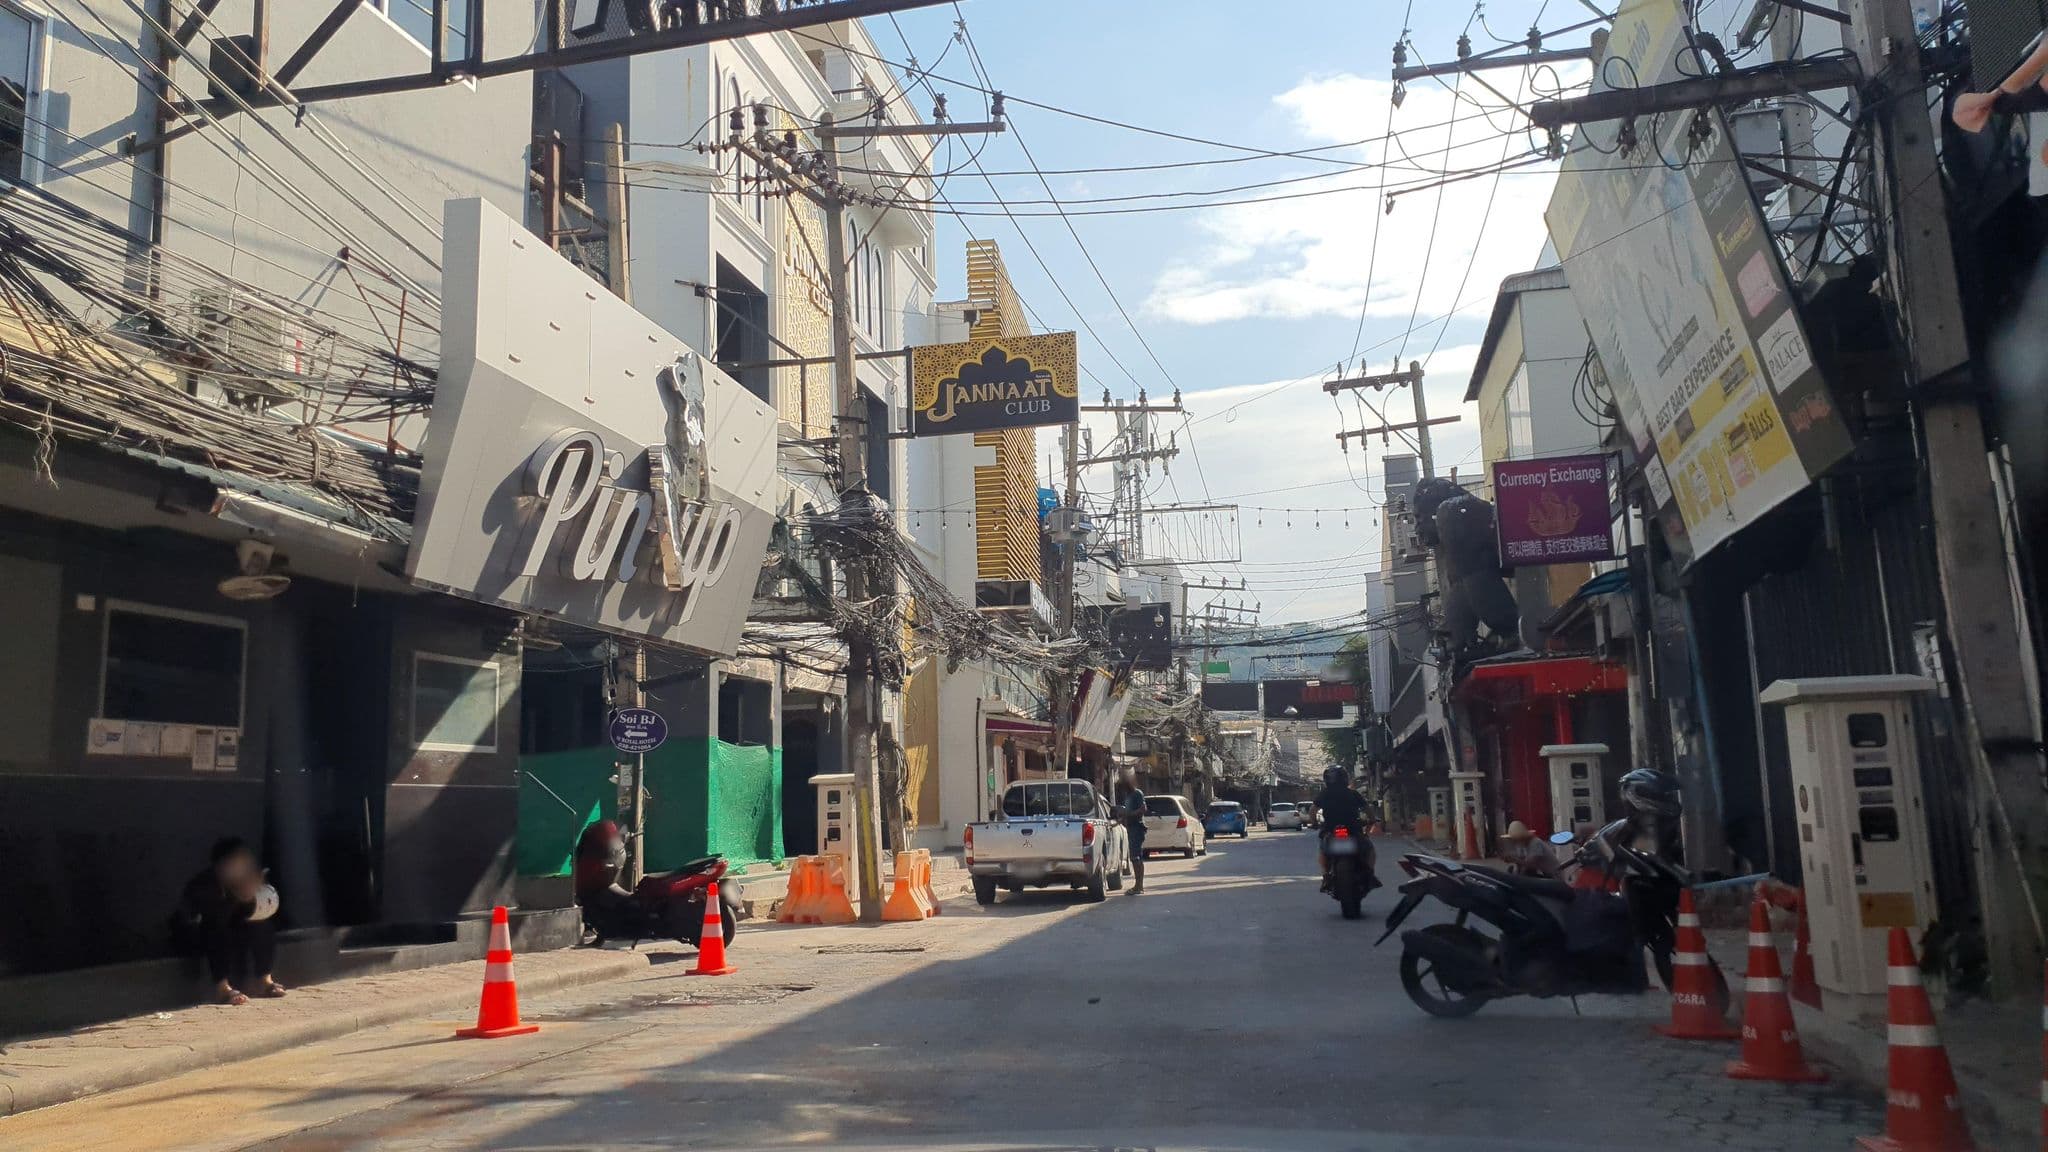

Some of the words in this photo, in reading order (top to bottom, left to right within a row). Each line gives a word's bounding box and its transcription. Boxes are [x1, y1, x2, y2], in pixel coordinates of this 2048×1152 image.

[1684, 326, 1736, 399] EXPERIENCE
[1768, 335, 1804, 377] PALACE
[926, 378, 1052, 423] JANNAAT
[1005, 400, 1051, 415] CLUB
[1499, 472, 1547, 488] Currency
[1549, 466, 1602, 484] Exchange
[522, 428, 653, 582] Pin
[619, 714, 637, 724] Soi
[640, 715, 656, 725] BJ
